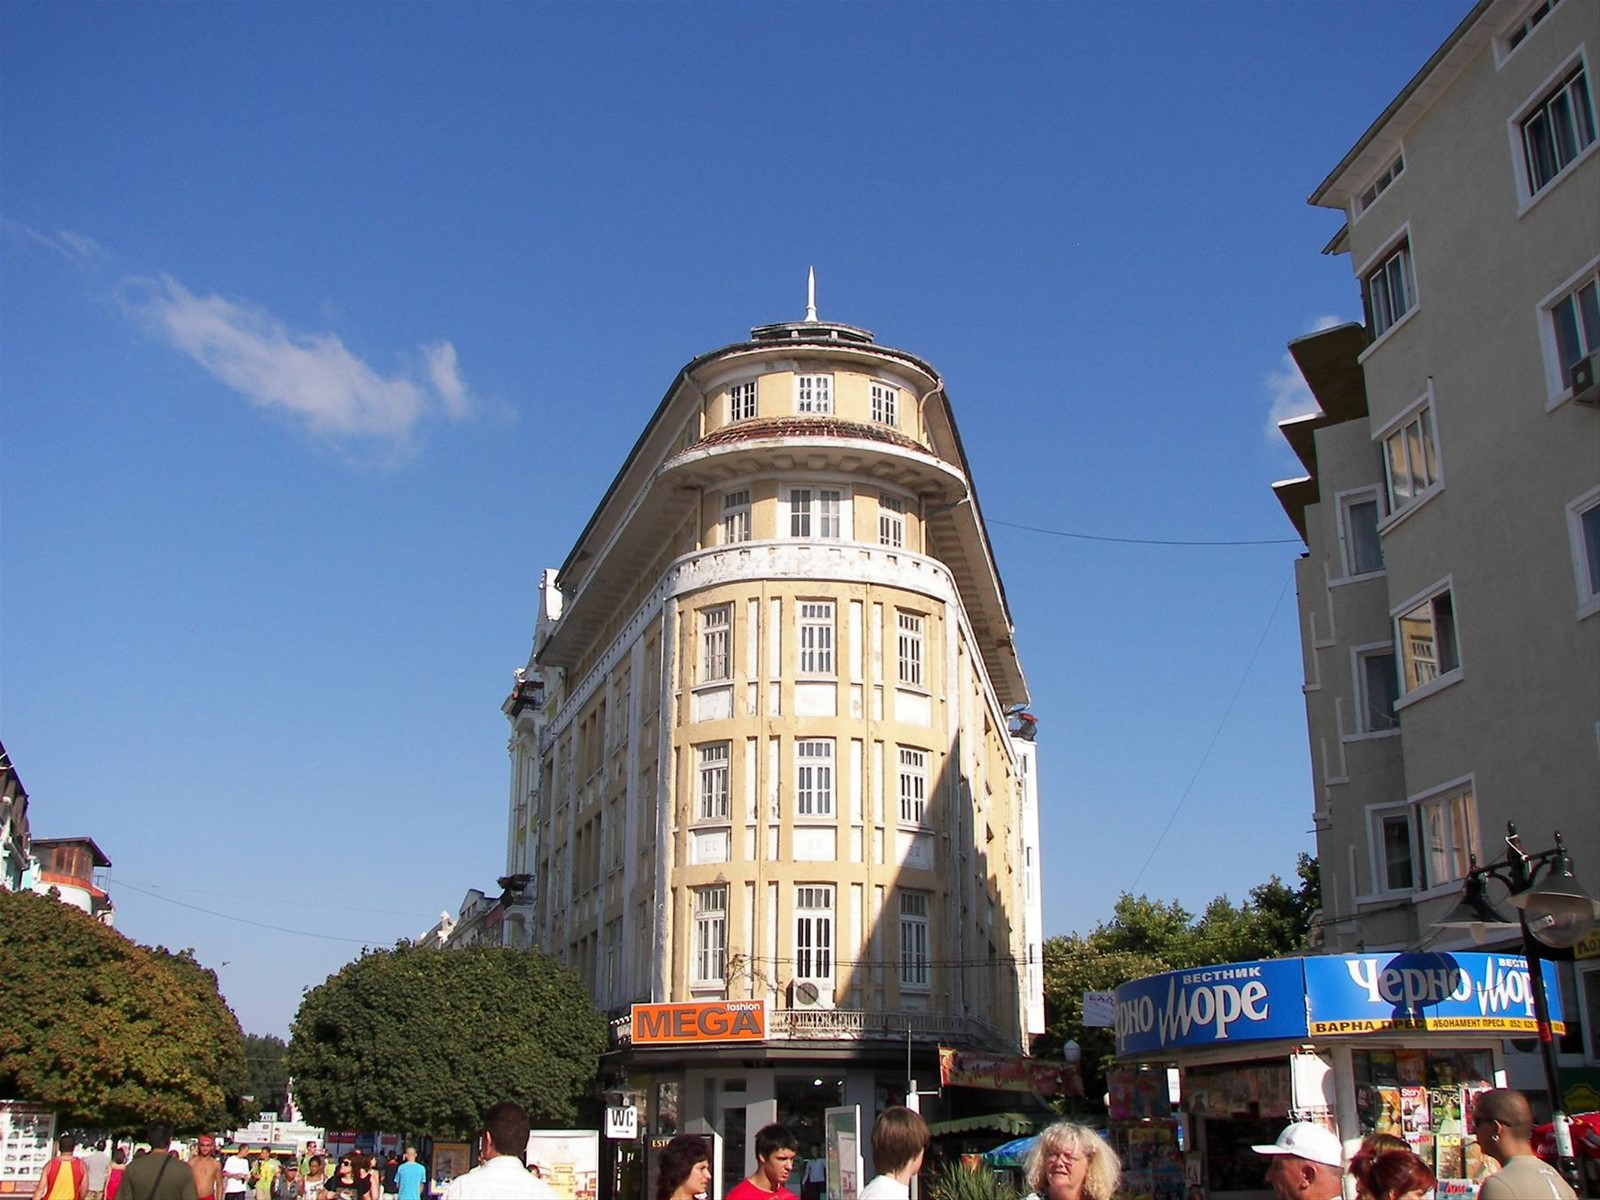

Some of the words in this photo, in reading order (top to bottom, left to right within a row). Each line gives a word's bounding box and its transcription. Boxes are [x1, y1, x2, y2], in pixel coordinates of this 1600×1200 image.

[1183, 967, 1261, 984] ВЕСТНИК
[1345, 959, 1472, 1014] Черно
[1476, 956, 1548, 1016] Мор
[727, 1002, 760, 1012] fashion
[1158, 976, 1269, 1047] Море
[637, 1008, 762, 1038] MEGA
[1315, 1021, 1375, 1033] ВАРНА
[1381, 1019, 1425, 1030] ПРЕС
[1433, 1018, 1481, 1028] АБОНАМЕНТ
[1482, 1019, 1506, 1028] ПРЕСА
[611, 1109, 634, 1127] WC
